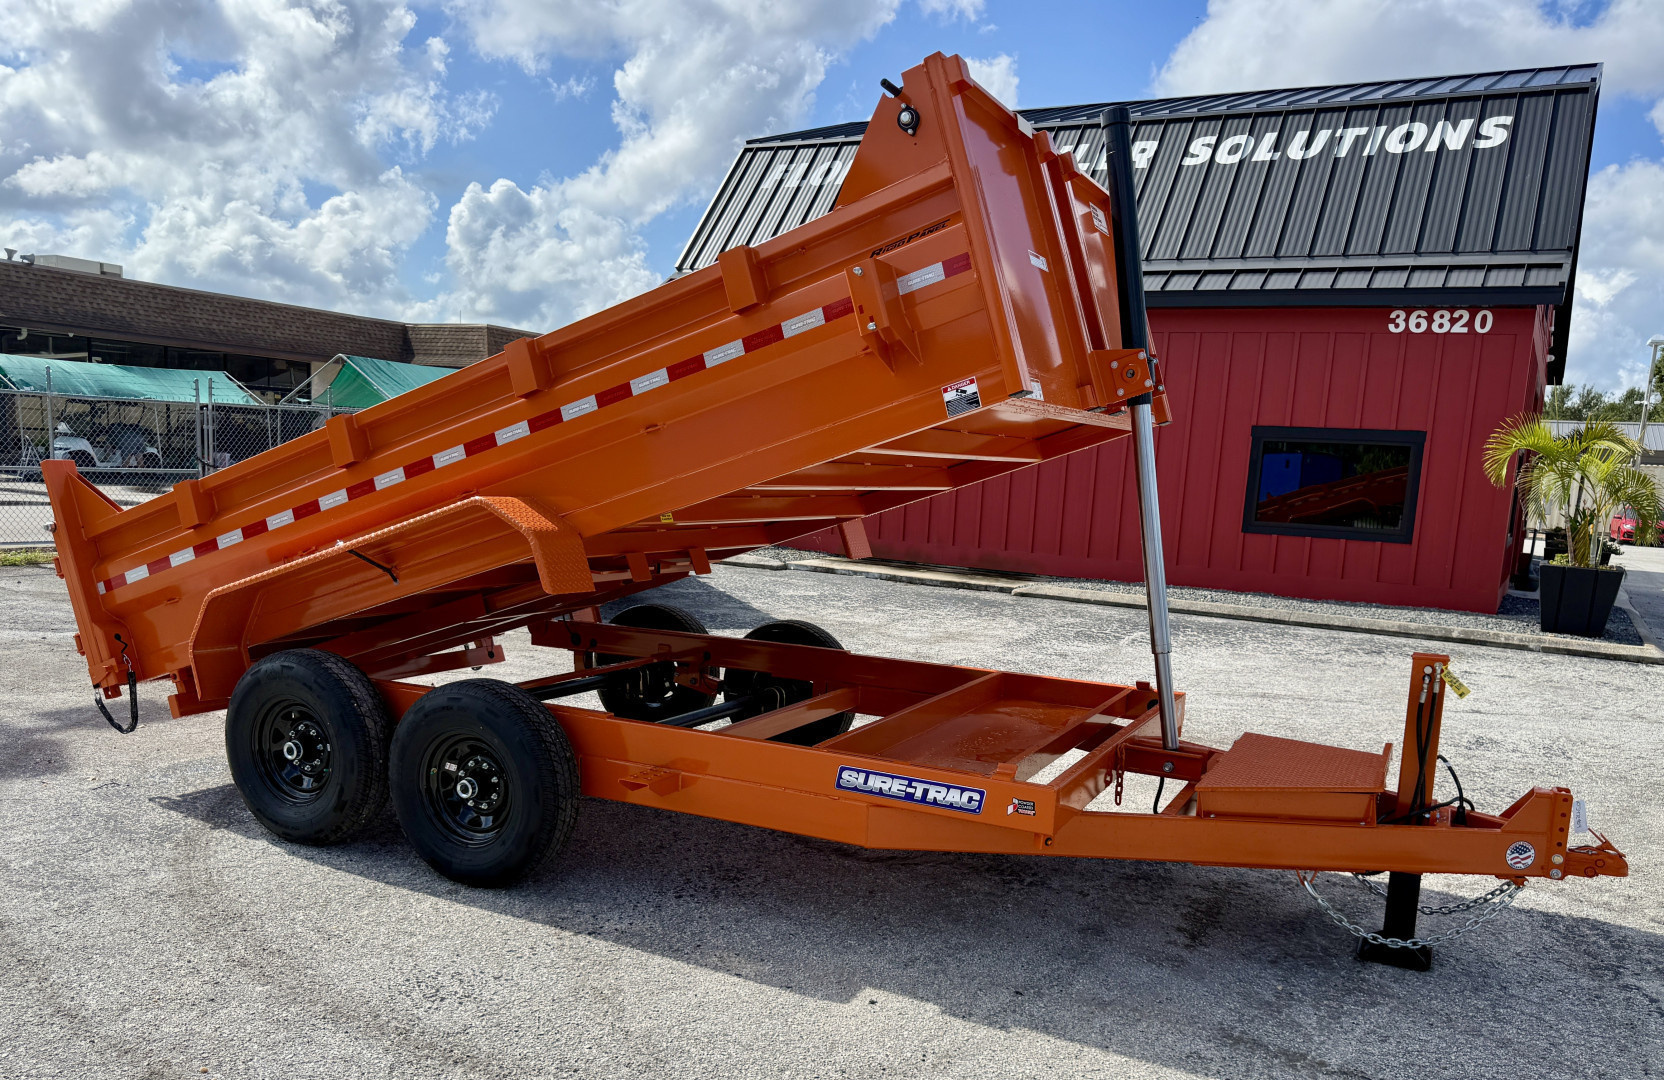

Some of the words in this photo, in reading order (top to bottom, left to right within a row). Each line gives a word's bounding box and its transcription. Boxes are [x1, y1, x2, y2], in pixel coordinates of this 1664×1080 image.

[1181, 115, 1514, 166] SOLUTIONS
[1388, 309, 1493, 334] 36820
[839, 769, 981, 810] SURE-TRAC
